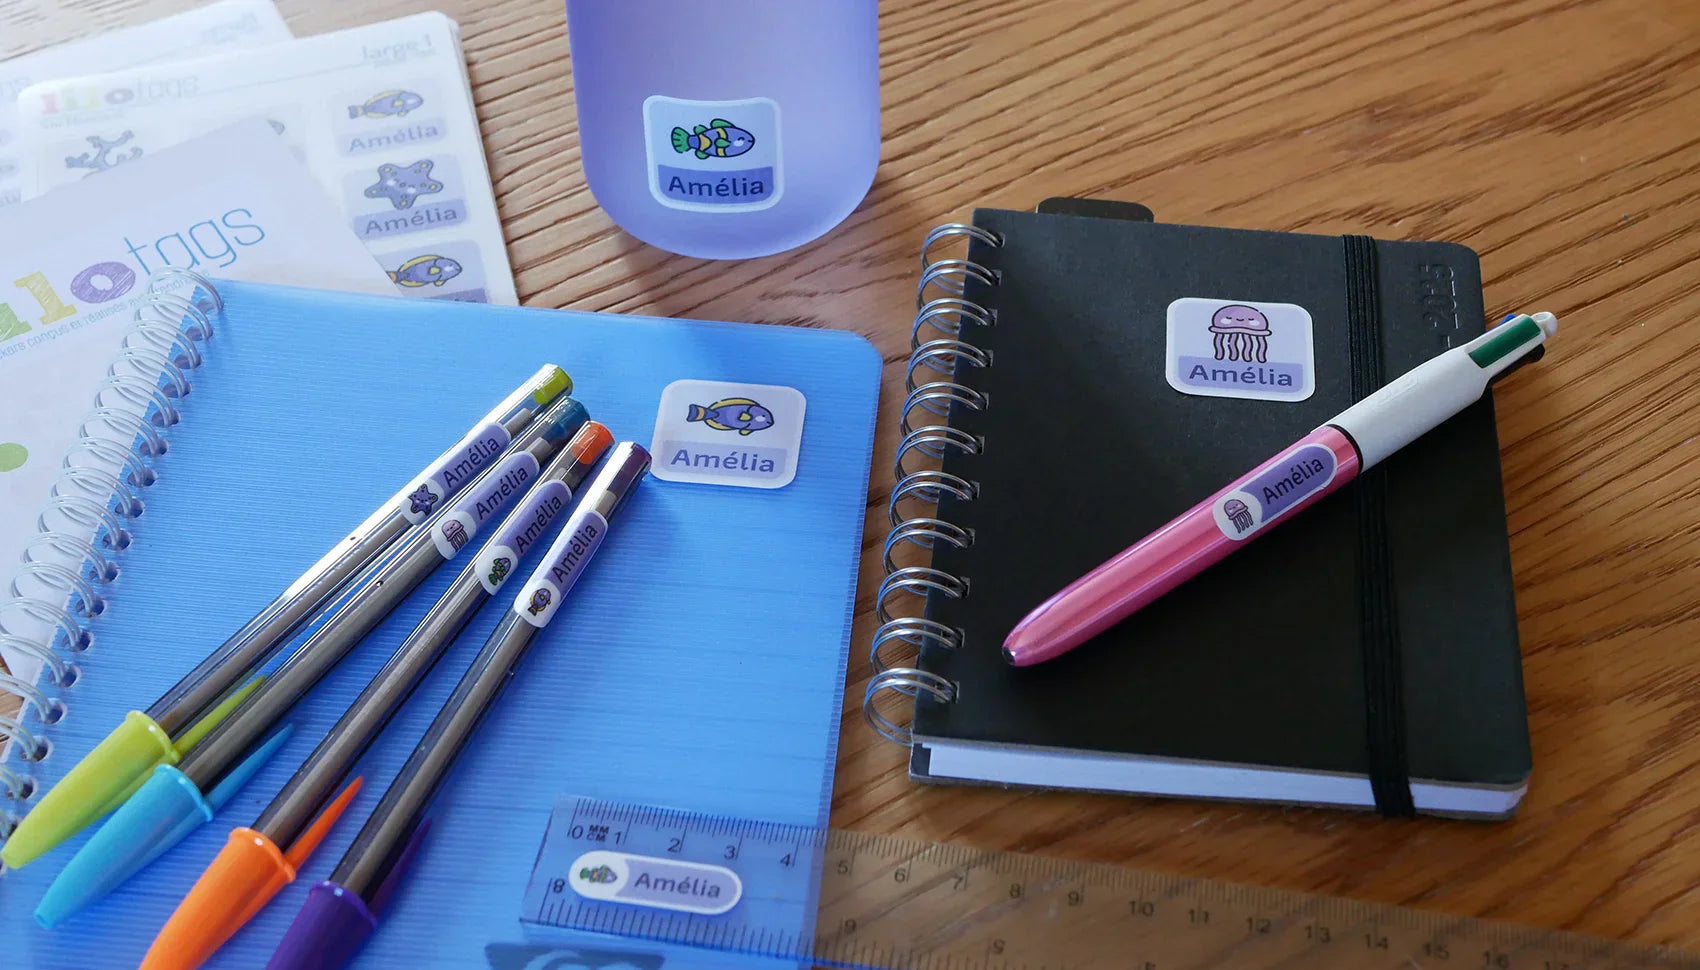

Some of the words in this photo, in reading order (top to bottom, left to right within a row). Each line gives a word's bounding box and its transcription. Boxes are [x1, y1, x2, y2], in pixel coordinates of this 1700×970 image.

[350, 124, 439, 152] Amélia
[668, 176, 764, 197] Amélia
[365, 207, 458, 235] Amélia
[1188, 364, 1293, 387] Amélia
[442, 437, 501, 489] Amélia
[670, 449, 775, 473] Amélia
[475, 466, 529, 521] Amélia
[1262, 457, 1325, 505] Amélia
[514, 495, 564, 554] Amélia
[551, 523, 598, 584] Amélia
[571, 825, 584, 840] 0
[614, 831, 622, 845] 1
[667, 838, 681, 853] 2
[724, 845, 737, 860] 3
[780, 854, 792, 867] 4
[837, 860, 849, 875] 5
[894, 868, 907, 883] 6
[952, 872, 964, 890] 7
[1009, 883, 1021, 899] 8
[1068, 890, 1080, 906] 9
[1129, 900, 1154, 917] 10
[1246, 917, 1272, 934] 12
[1304, 925, 1332, 943] 13
[1365, 934, 1390, 950] 14
[633, 872, 722, 900] Amélia
